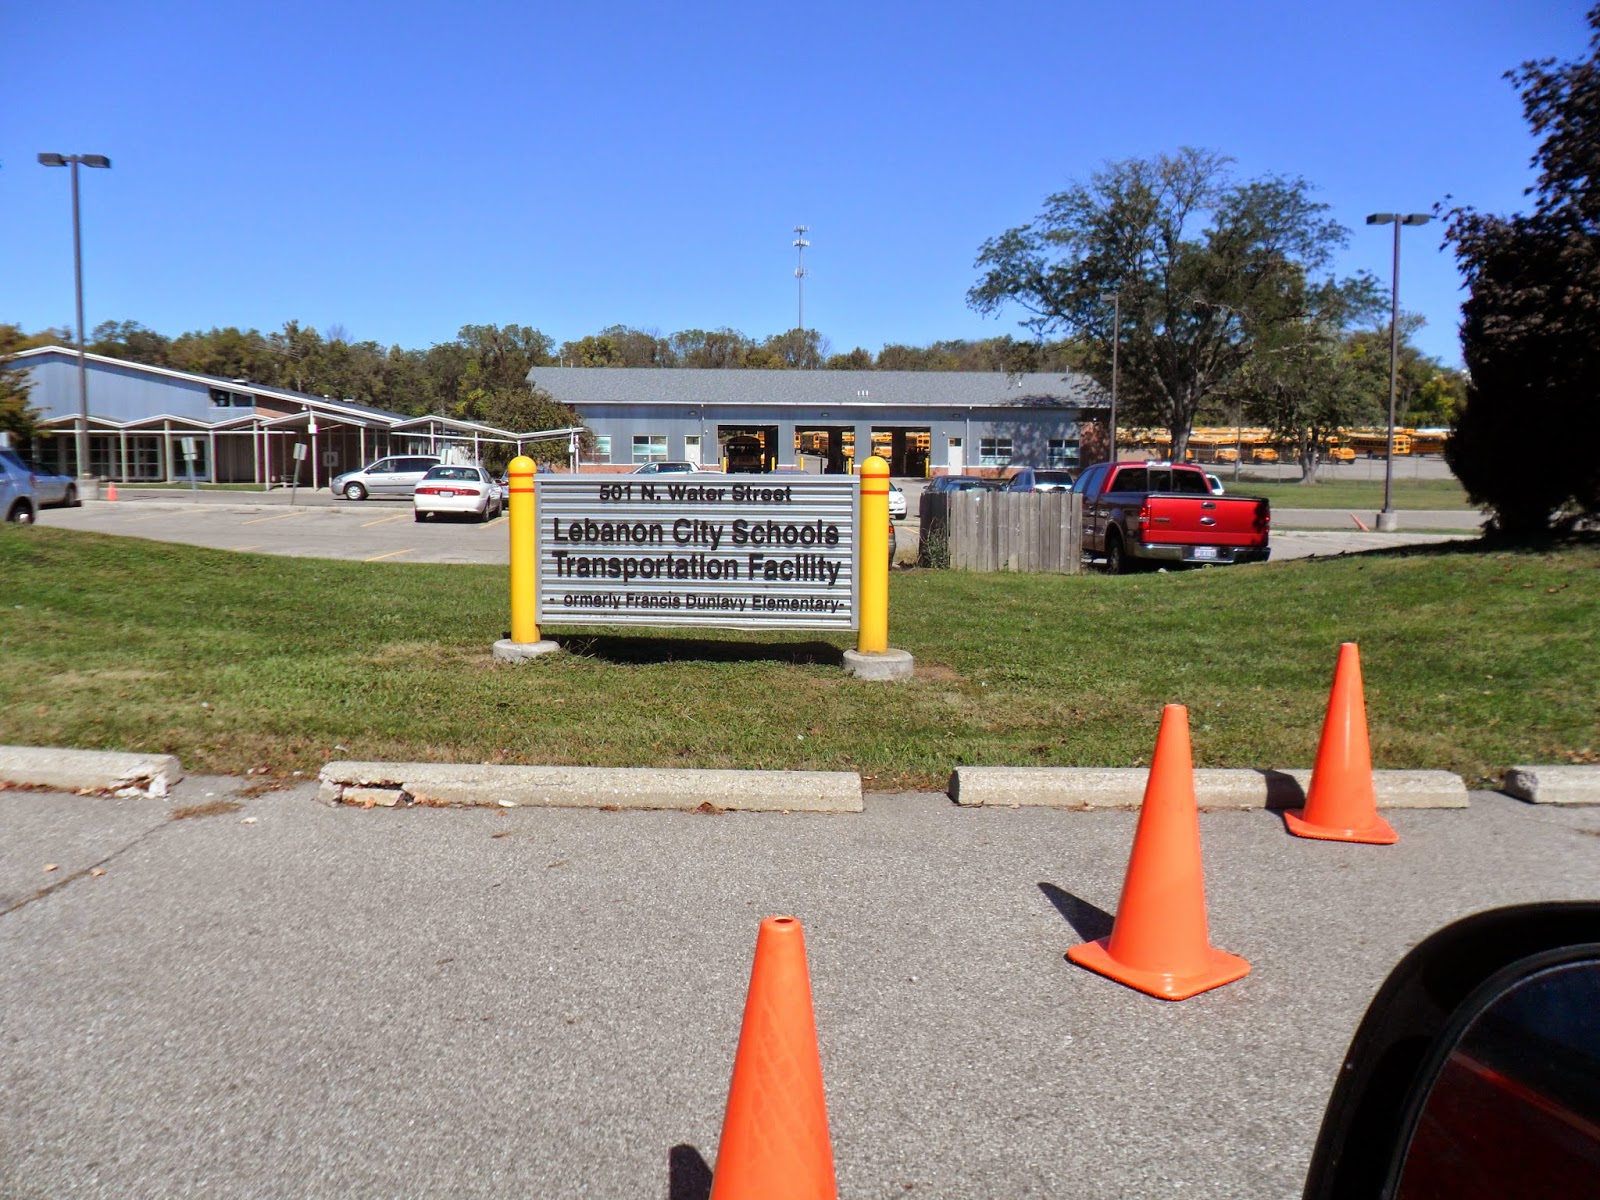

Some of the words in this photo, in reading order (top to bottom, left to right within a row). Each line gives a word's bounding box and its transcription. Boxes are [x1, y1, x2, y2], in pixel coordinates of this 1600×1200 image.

[600, 484, 632, 501] 501
[640, 485, 661, 501] N.
[668, 485, 725, 501] Water
[732, 483, 792, 501] Street
[553, 517, 663, 543] Lebanon
[672, 518, 723, 550] City
[732, 519, 839, 545] Schools
[552, 550, 738, 583] Transportation
[748, 553, 841, 585] Facility
[626, 591, 681, 609] Francis
[686, 594, 747, 611] Dunlavy
